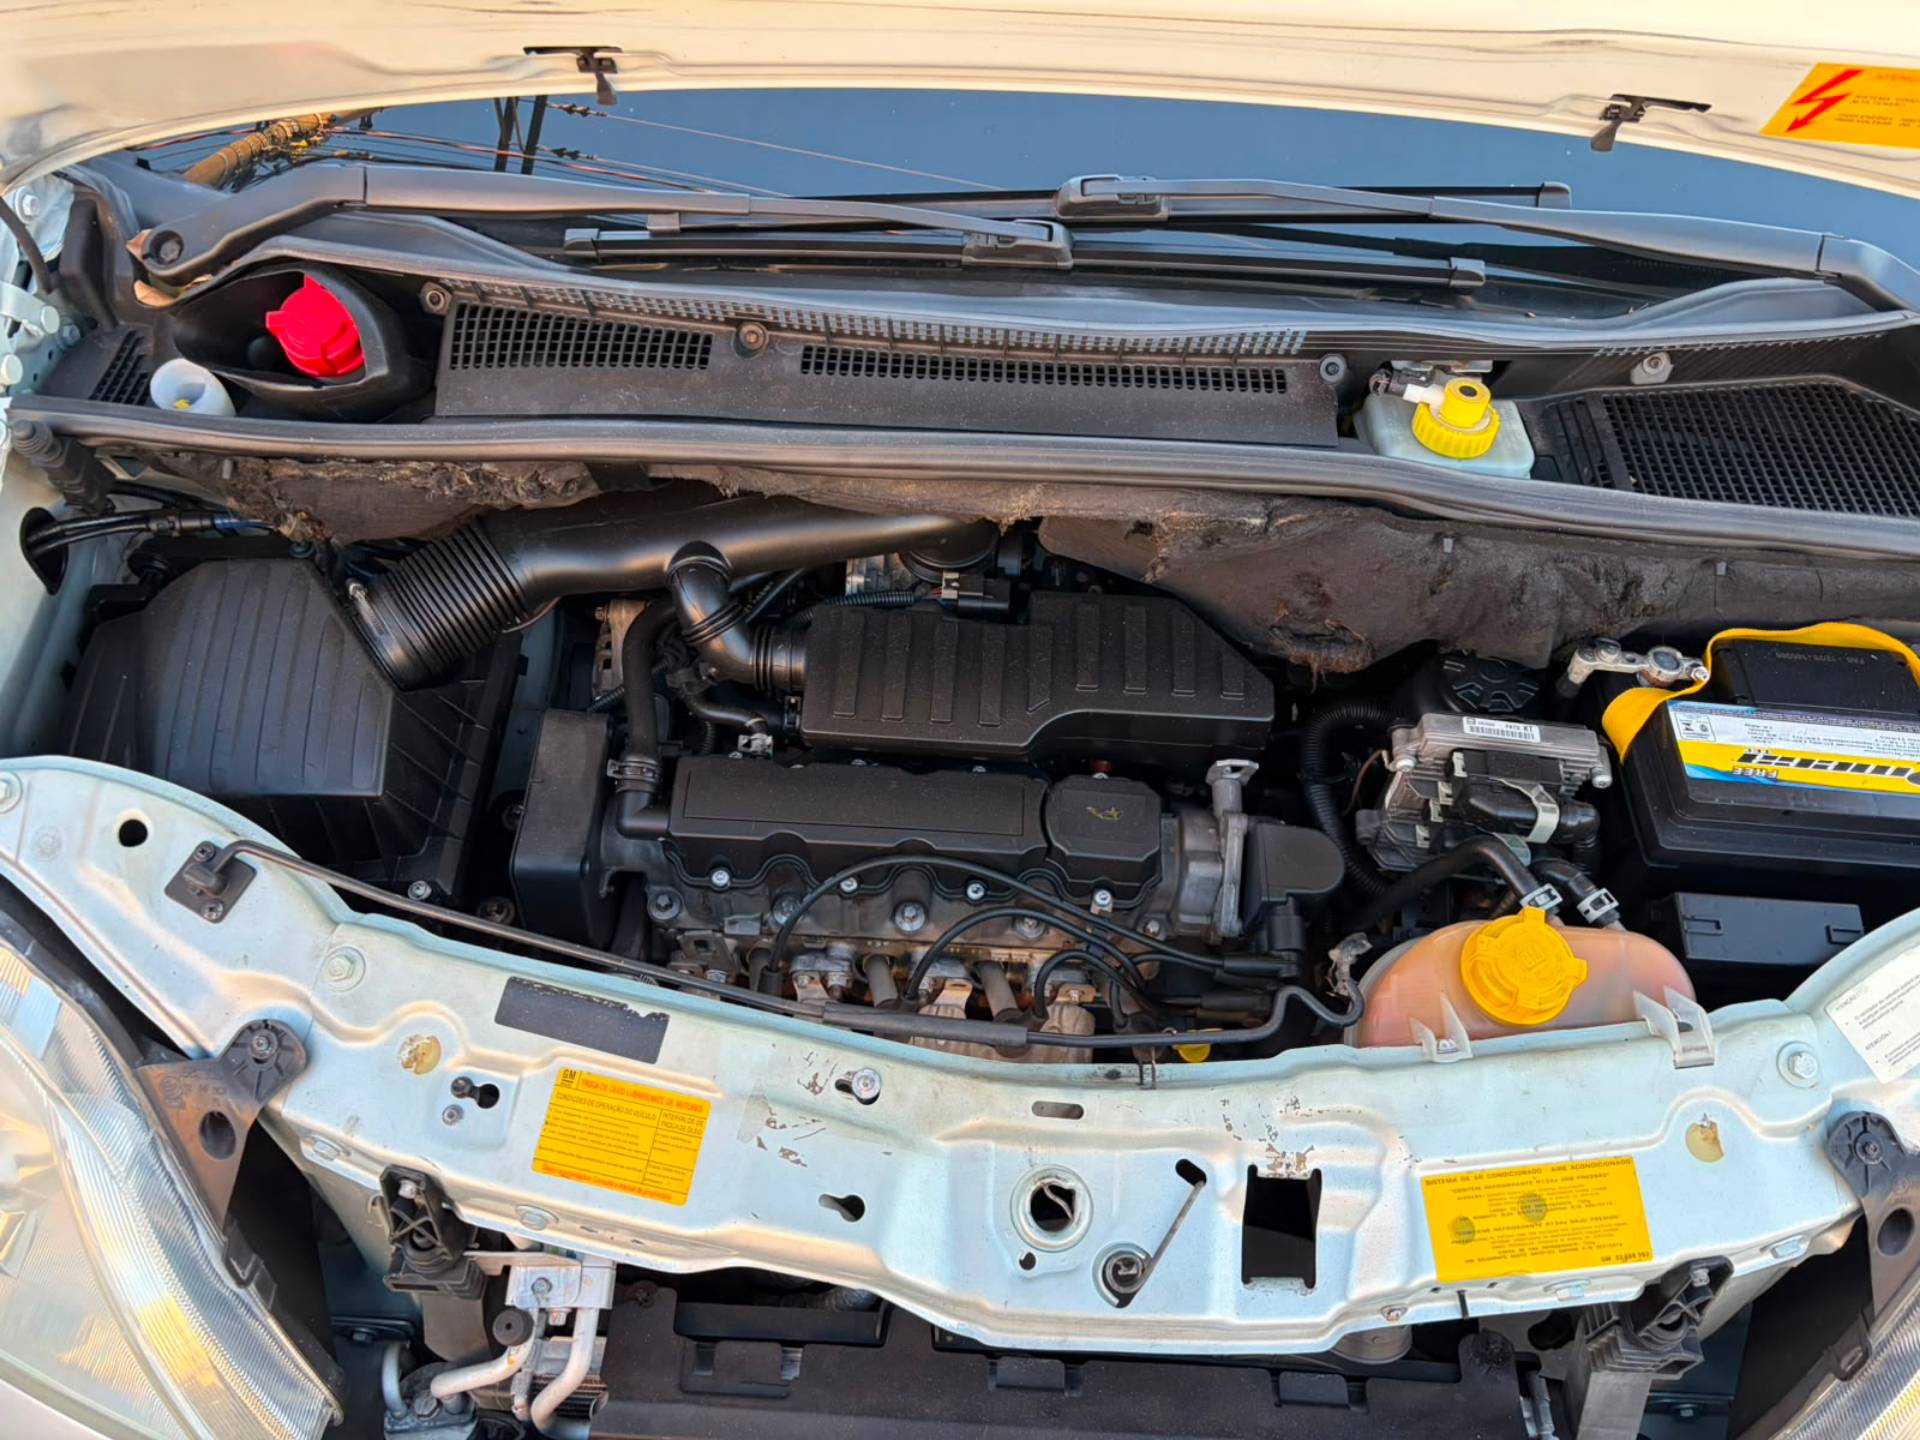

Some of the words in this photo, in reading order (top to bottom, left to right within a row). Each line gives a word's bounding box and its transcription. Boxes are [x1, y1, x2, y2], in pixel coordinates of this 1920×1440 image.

[1733, 767, 1778, 778] FREE
[562, 1068, 576, 1080] GM
[1425, 1176, 1457, 1186] SISTEMA
[1487, 1168, 1543, 1179] CONDICIONADO
[1571, 1159, 1631, 1170] ACONDICIONADO
